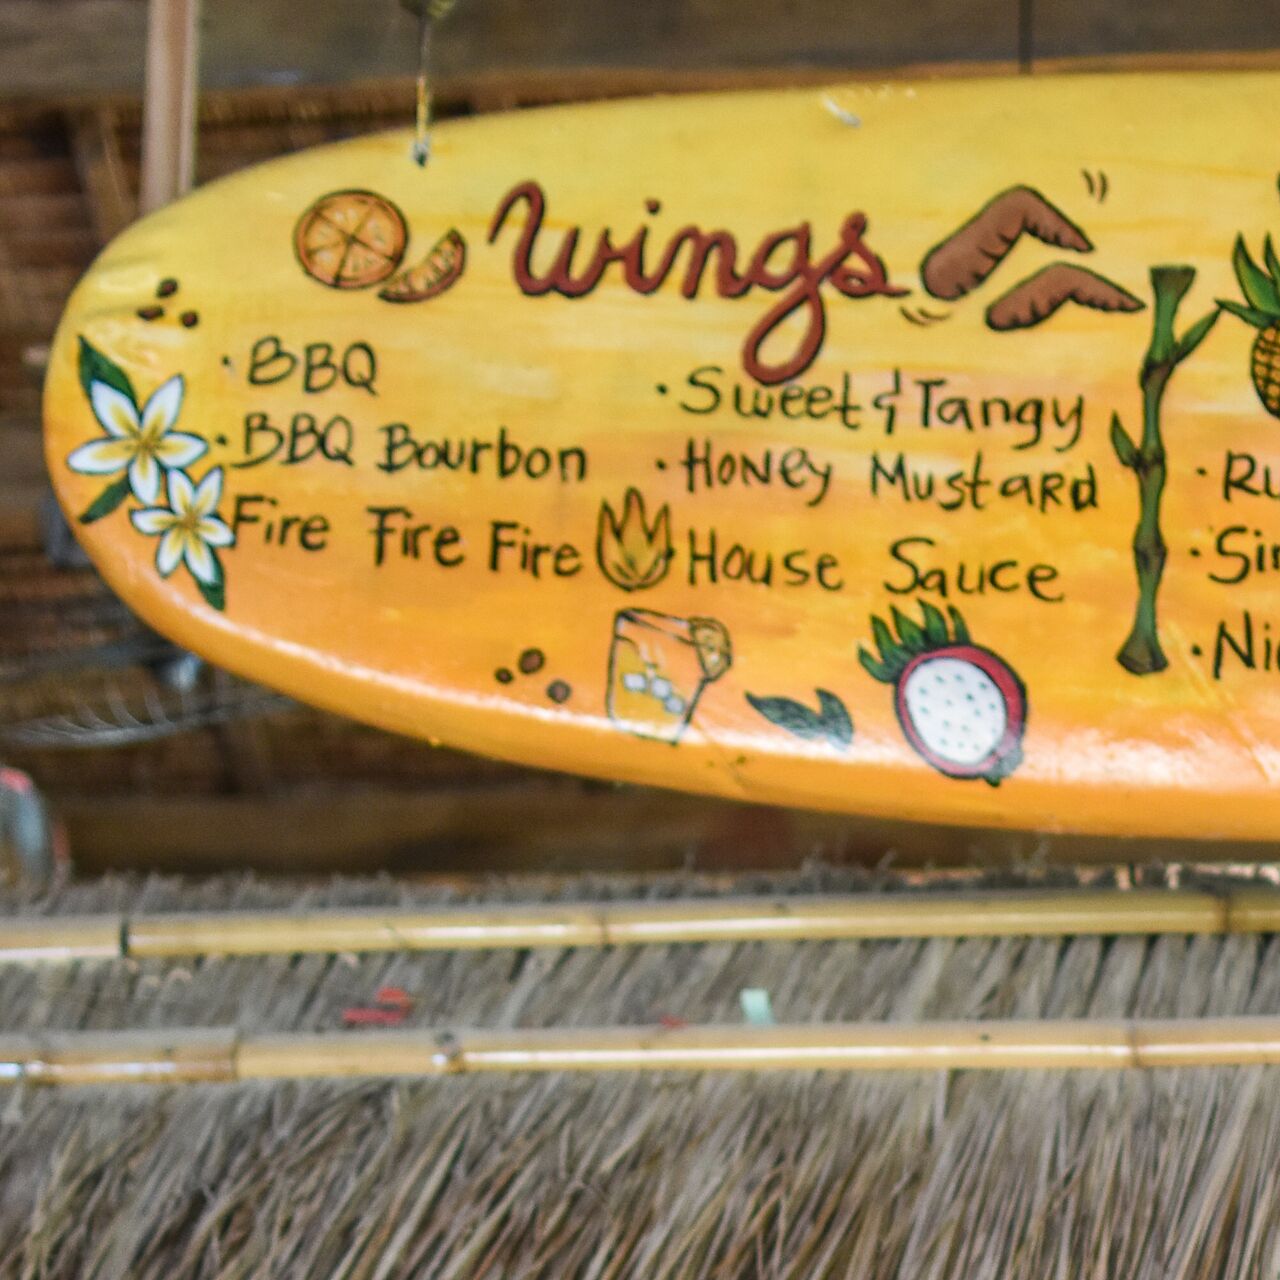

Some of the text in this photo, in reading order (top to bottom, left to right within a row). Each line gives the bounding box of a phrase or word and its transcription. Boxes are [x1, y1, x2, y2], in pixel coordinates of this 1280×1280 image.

[488, 179, 912, 385] Wings
[247, 335, 379, 397] BBQ
[227, 412, 588, 482] BBQ Bourbon
[679, 365, 862, 431] Sweet
[913, 377, 1085, 453] Tangy
[231, 494, 585, 579] Fire Fire Fire
[687, 526, 1066, 602] House Sauce
